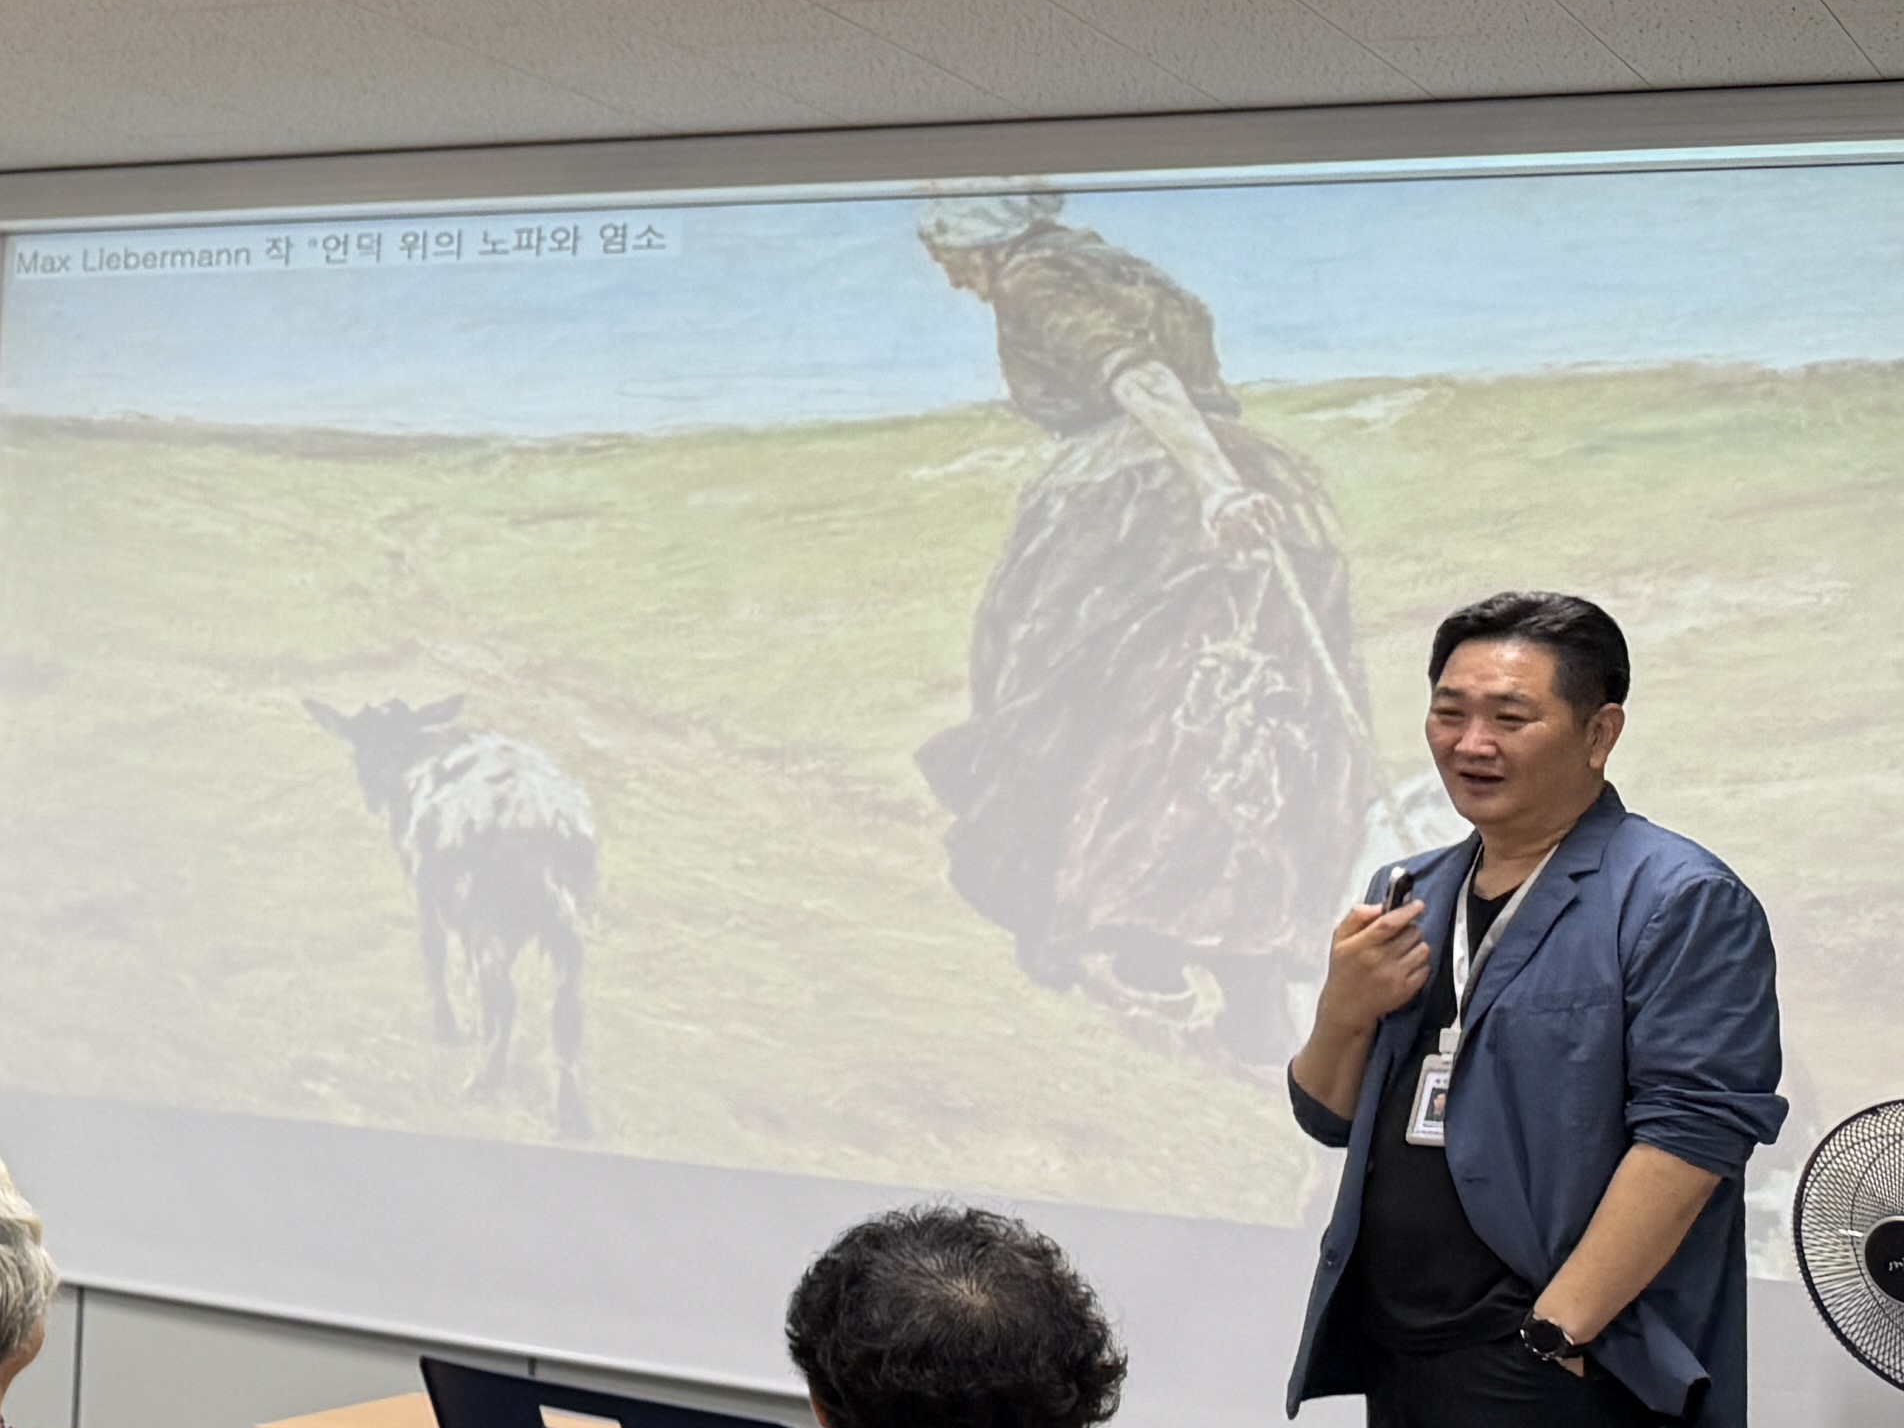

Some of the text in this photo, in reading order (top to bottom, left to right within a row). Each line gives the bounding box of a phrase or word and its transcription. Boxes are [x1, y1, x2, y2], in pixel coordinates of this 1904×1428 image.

[15, 251, 72, 274] Max
[82, 244, 252, 272] Liebermann
[265, 236, 293, 267] 작
[398, 229, 463, 261] 위의
[478, 225, 582, 258] 노파와
[600, 224, 666, 255] 염소
